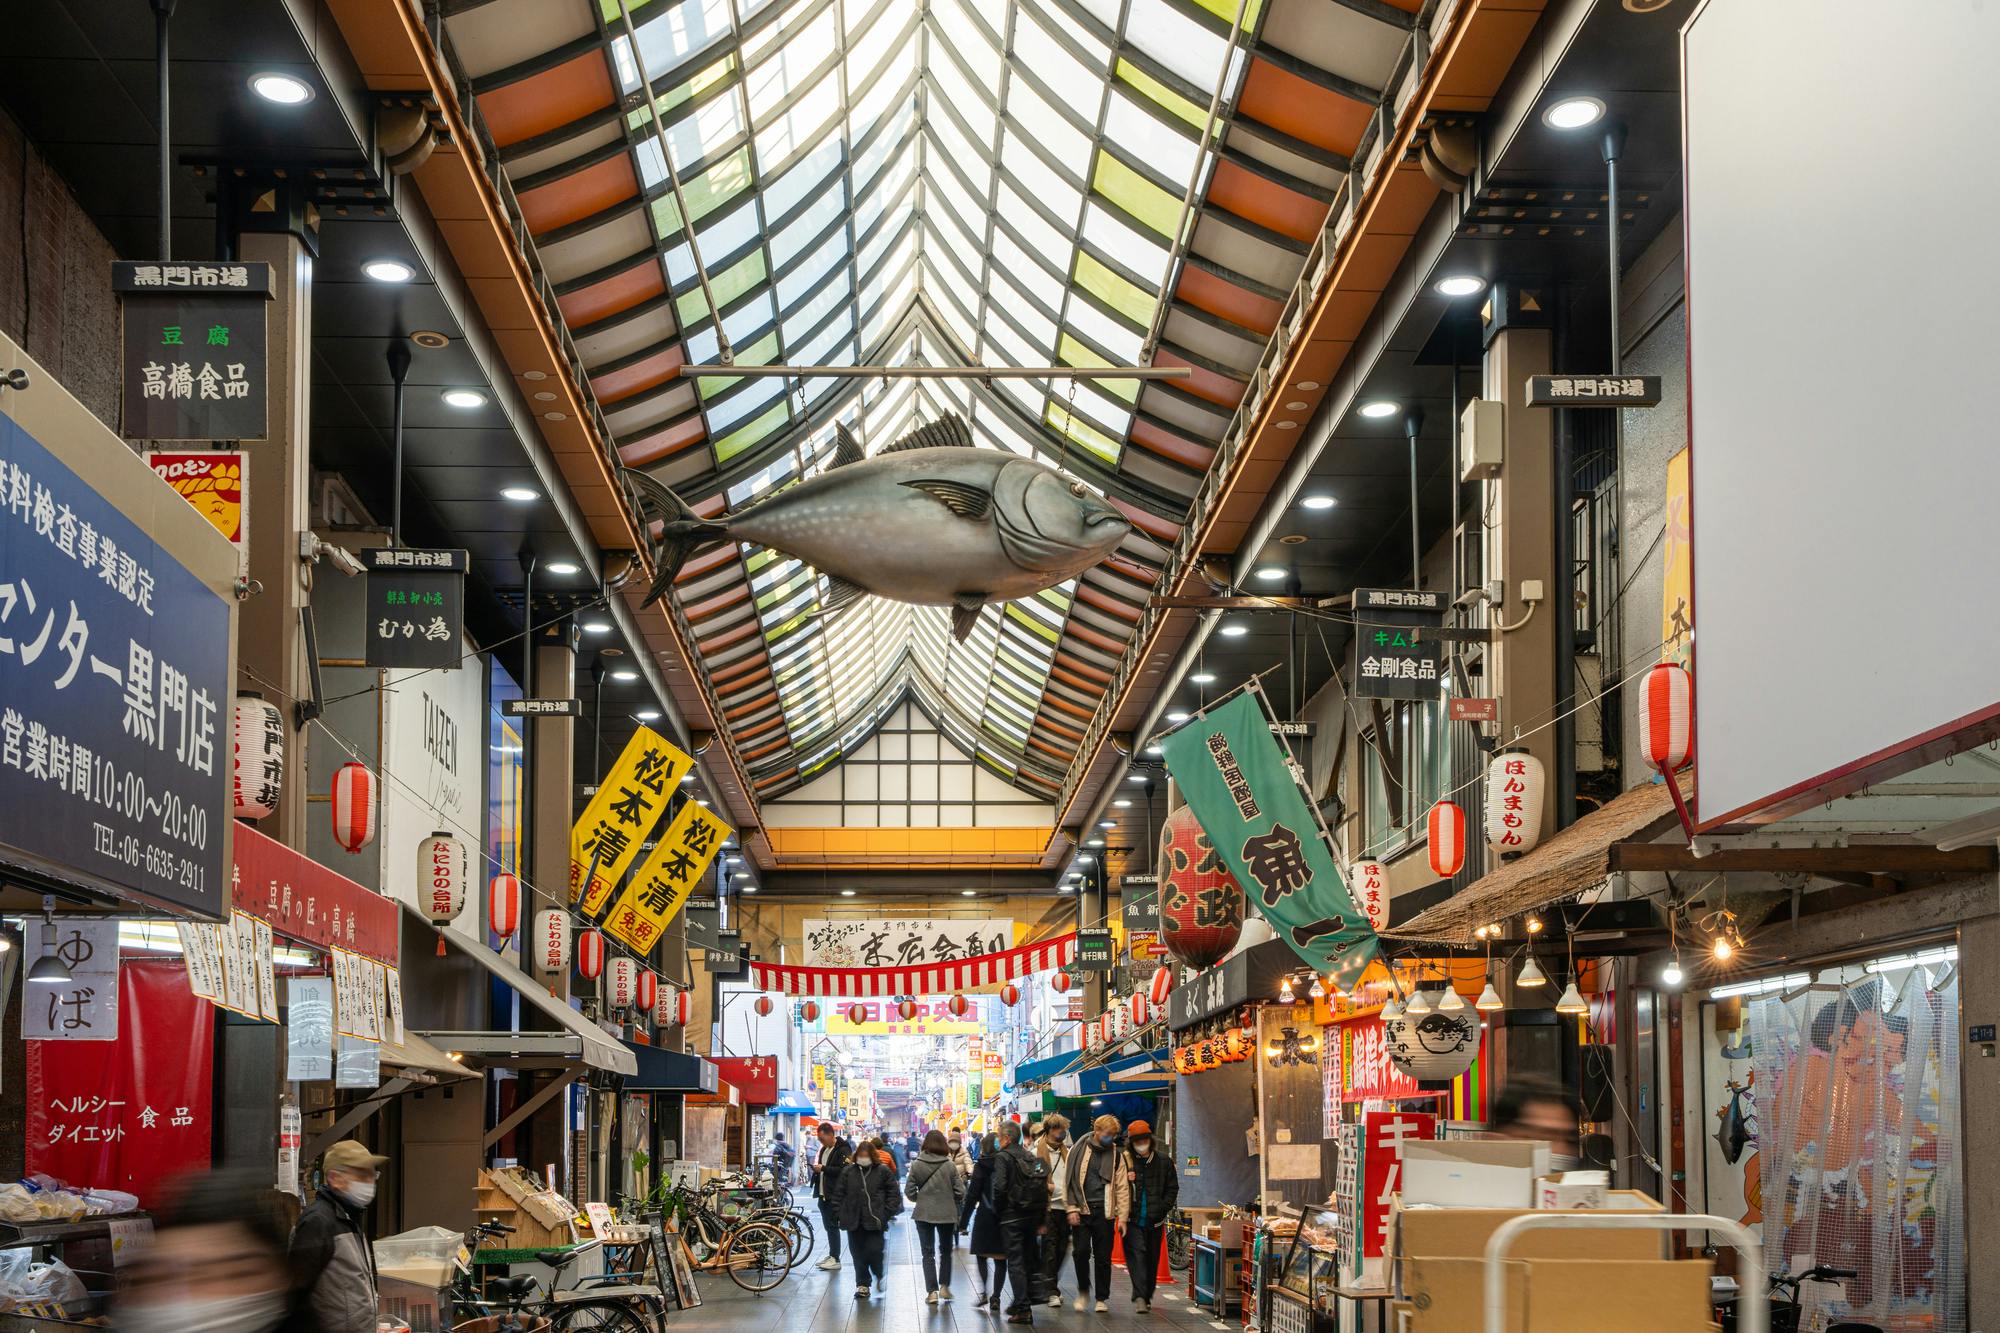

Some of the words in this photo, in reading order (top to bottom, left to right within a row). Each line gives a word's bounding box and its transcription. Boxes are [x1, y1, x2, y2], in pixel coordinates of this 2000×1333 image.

[134, 266, 249, 287] 黒門市場
[161, 324, 230, 347] 豆腐
[141, 361, 250, 401] 高橋食品
[1550, 379, 1645, 398] 黒門市場
[375, 551, 453, 567] 黒門市場
[1368, 592, 1437, 607] 黒門市場
[379, 616, 451, 641] むか為
[1361, 656, 1437, 680] 金剛食品
[512, 701, 569, 712] 黒門市場
[423, 690, 457, 777] TAIZEN
[1269, 723, 1308, 735] 門市場
[583, 748, 675, 869] 松本清
[1500, 760, 1527, 846] ほんまもん
[94, 821, 205, 894] TEL:06-6635-2911
[638, 816, 717, 916] 松本清
[433, 842, 451, 914] なにわの台所
[1364, 864, 1381, 929] ほんまもん
[547, 913, 562, 967] なにわの台所
[619, 910, 654, 942] 免税
[48, 930, 96, 1031] ゆば
[617, 960, 629, 1004] なにわの台所
[659, 987, 668, 1024] なにわの台所
[1120, 1007, 1128, 1038] ほんまもん
[744, 1058, 765, 1066] 寿司
[751, 1067, 775, 1078] すし
[50, 1096, 126, 1114] ヘルシー
[137, 1106, 194, 1128] 食品
[47, 1124, 126, 1144] ダイエット
